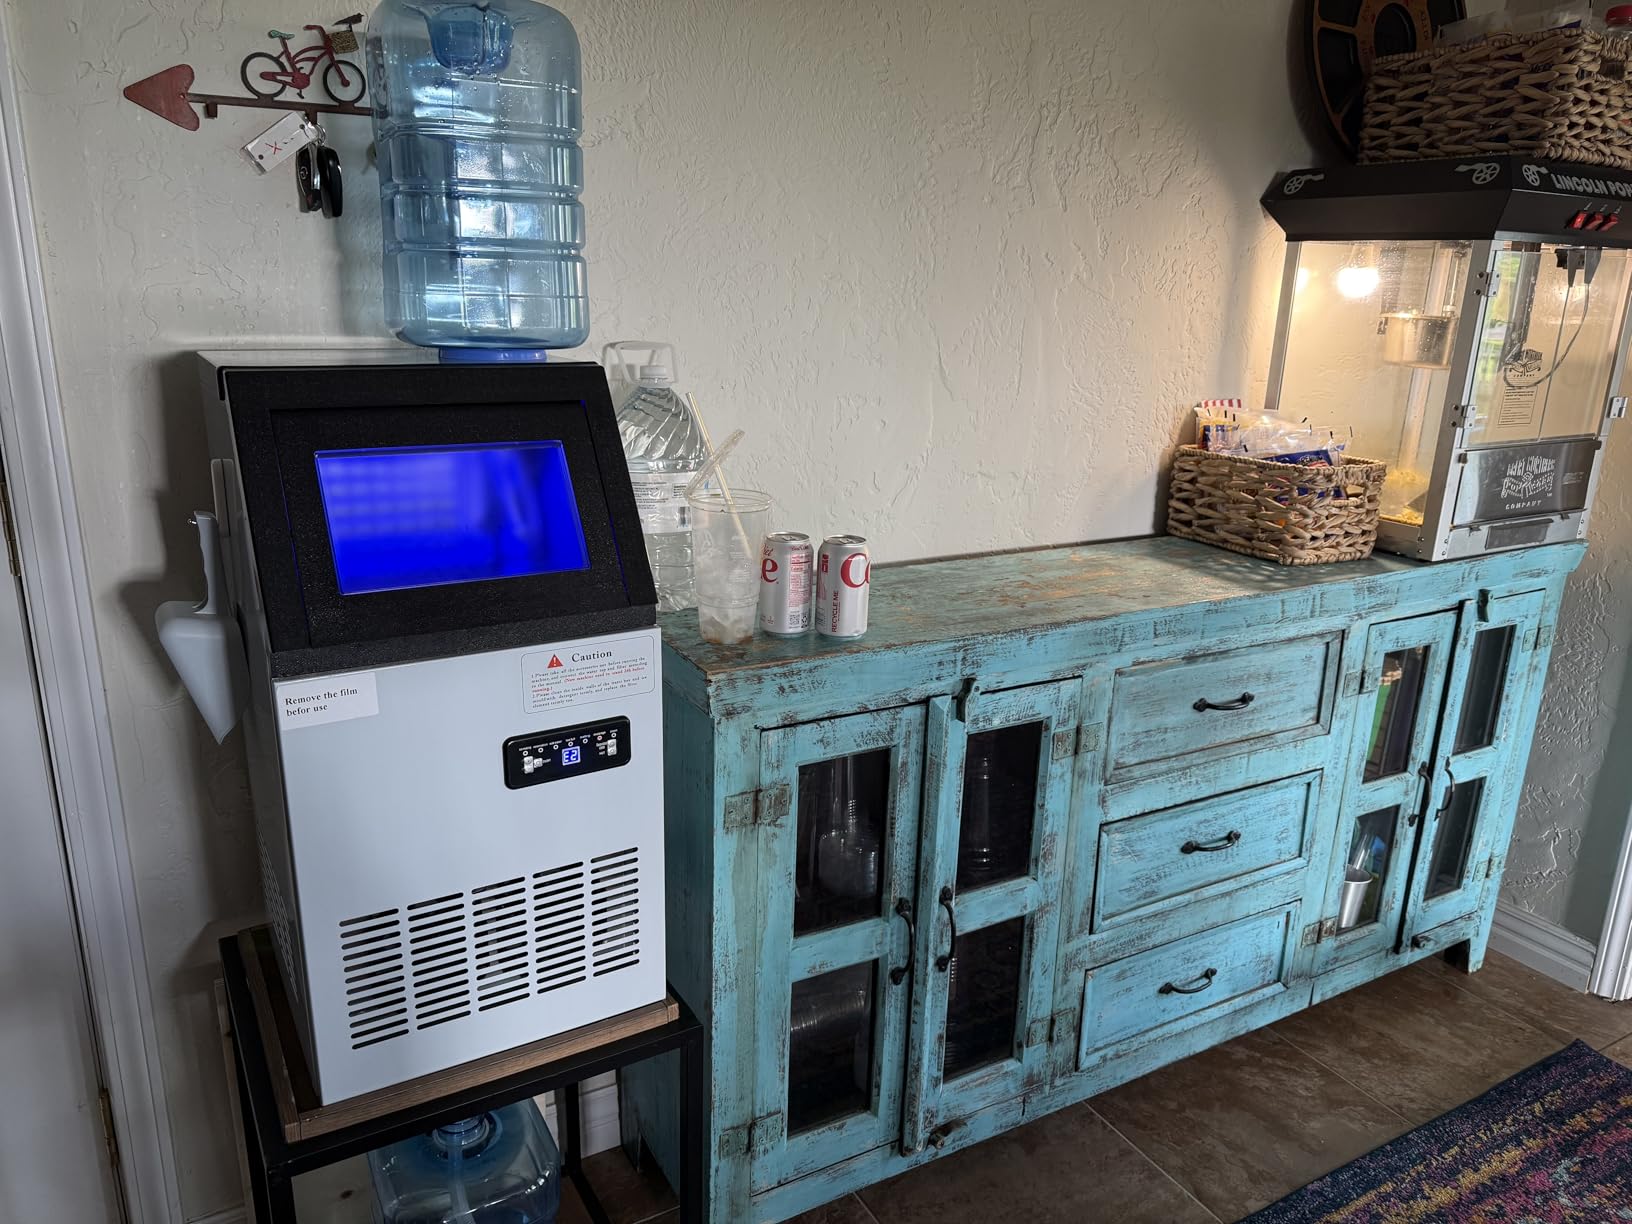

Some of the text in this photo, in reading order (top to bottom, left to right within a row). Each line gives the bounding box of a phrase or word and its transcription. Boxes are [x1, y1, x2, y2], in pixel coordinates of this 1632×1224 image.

[1551, 173, 1632, 198] LINCOLN POP
[833, 591, 839, 601] ME
[571, 650, 613, 663] Caution
[285, 688, 358, 706] Remove the film
[286, 704, 328, 717] befor use
[563, 749, 578, 763] E2
